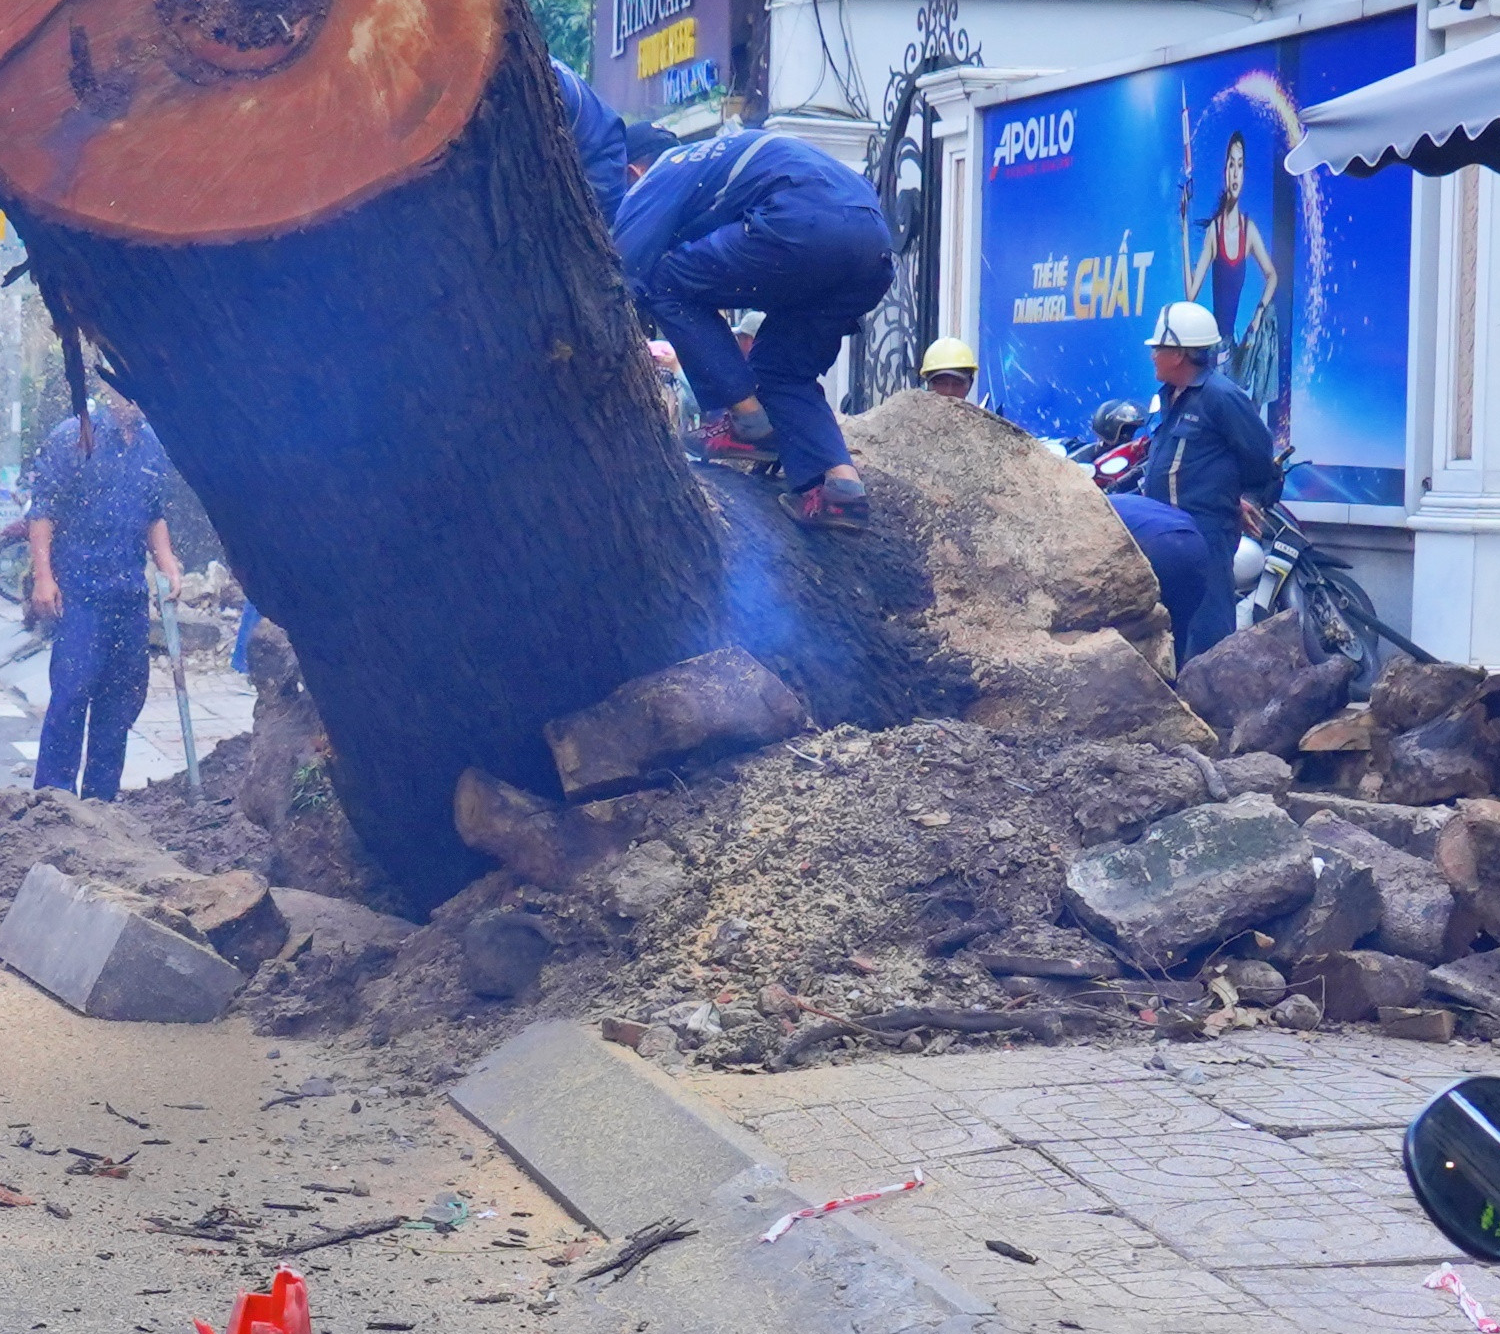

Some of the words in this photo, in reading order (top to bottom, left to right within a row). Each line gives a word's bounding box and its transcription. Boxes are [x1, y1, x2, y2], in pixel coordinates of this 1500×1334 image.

[989, 108, 1075, 181] APOLLO
[1043, 295, 1067, 322] KEO
[1072, 228, 1155, 320] CHẤT
